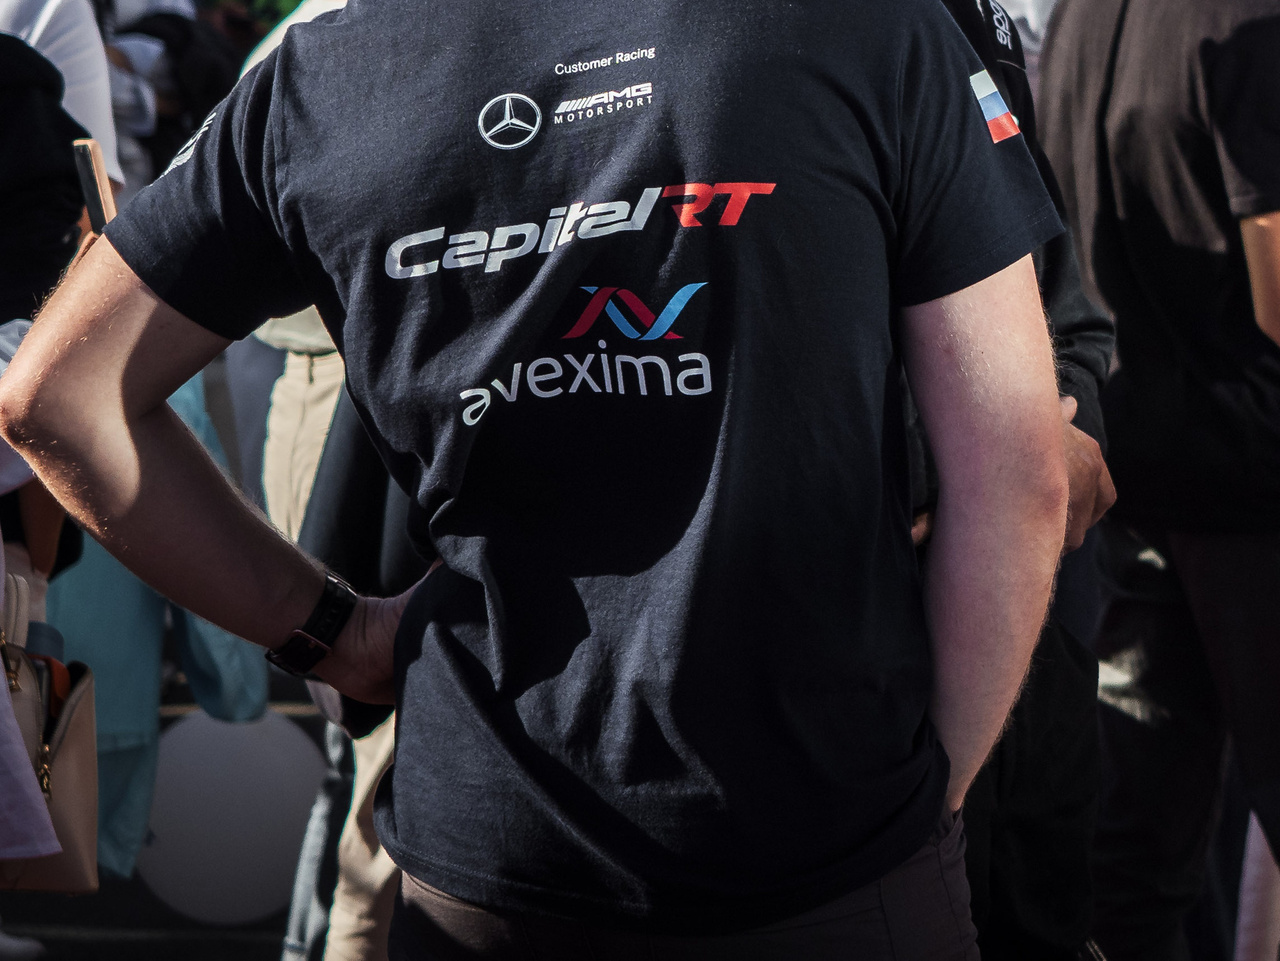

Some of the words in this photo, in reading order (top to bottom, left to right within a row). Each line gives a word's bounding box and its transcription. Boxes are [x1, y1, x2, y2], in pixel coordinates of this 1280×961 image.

[555, 56, 614, 75] Customer
[615, 47, 656, 64] Racing
[554, 95, 653, 124] MOTORSPORT
[459, 339, 712, 426] avexima
